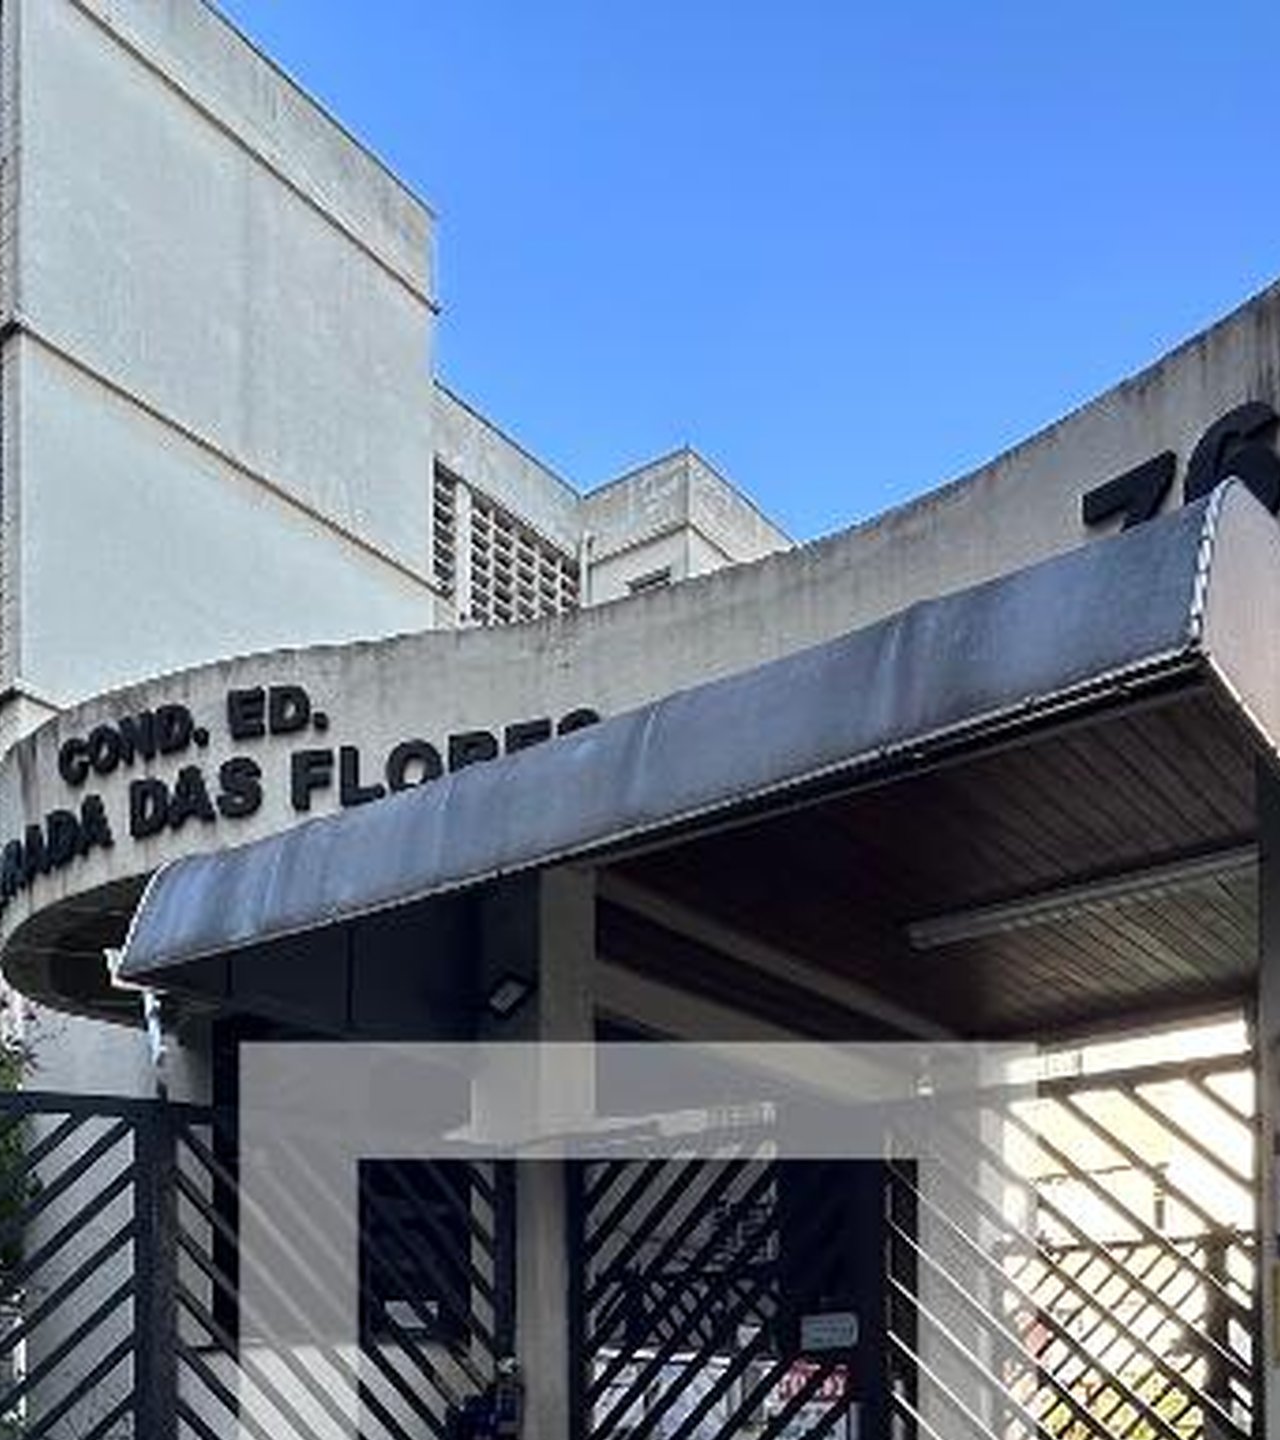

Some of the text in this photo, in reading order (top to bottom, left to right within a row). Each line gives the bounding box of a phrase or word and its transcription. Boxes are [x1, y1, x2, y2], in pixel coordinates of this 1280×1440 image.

[58, 685, 329, 788] COND. ED.
[129, 757, 261, 840] DAS
